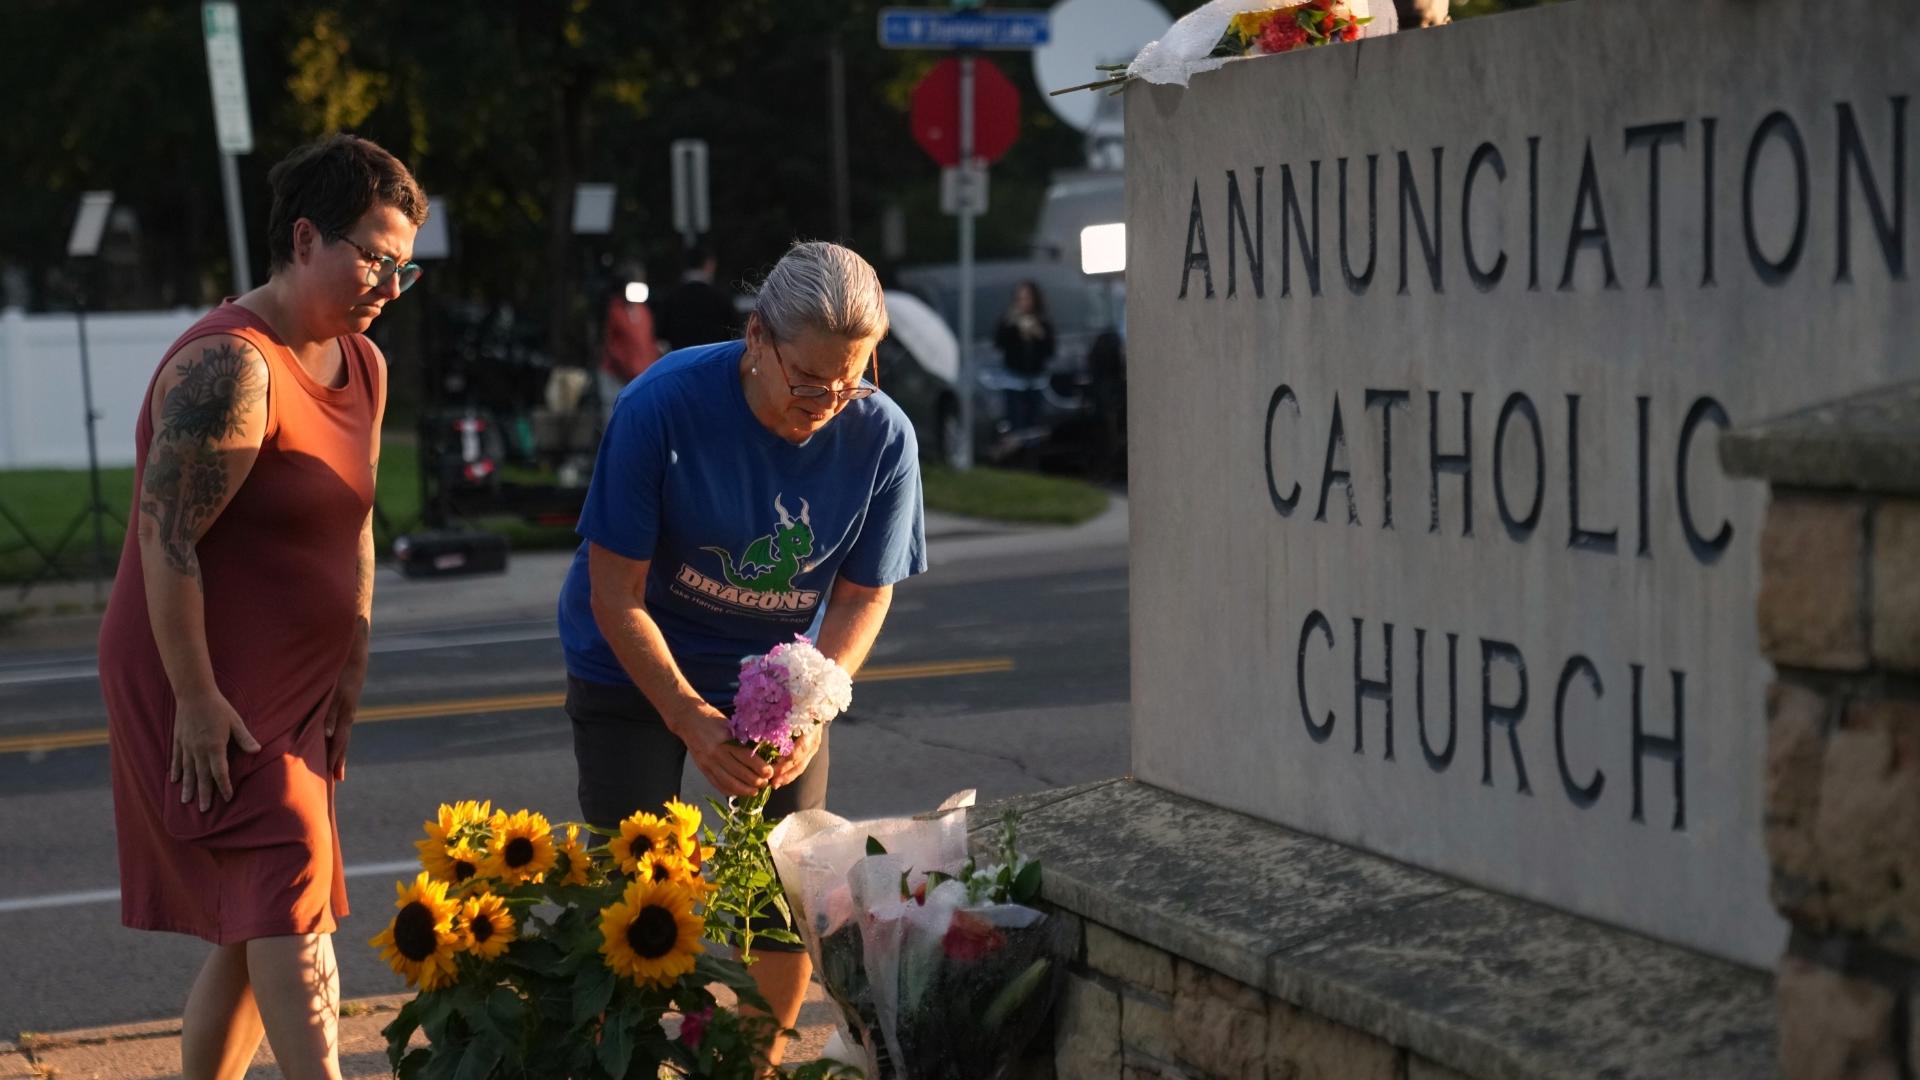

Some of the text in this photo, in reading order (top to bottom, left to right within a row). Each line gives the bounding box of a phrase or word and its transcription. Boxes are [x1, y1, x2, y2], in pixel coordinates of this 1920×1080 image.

[1178, 95, 1911, 300] ANNUNCIATION
[1263, 384, 1735, 566] CATHOLIC
[677, 565, 818, 611] DRAGONS
[1296, 609, 1686, 830] CHURCH
